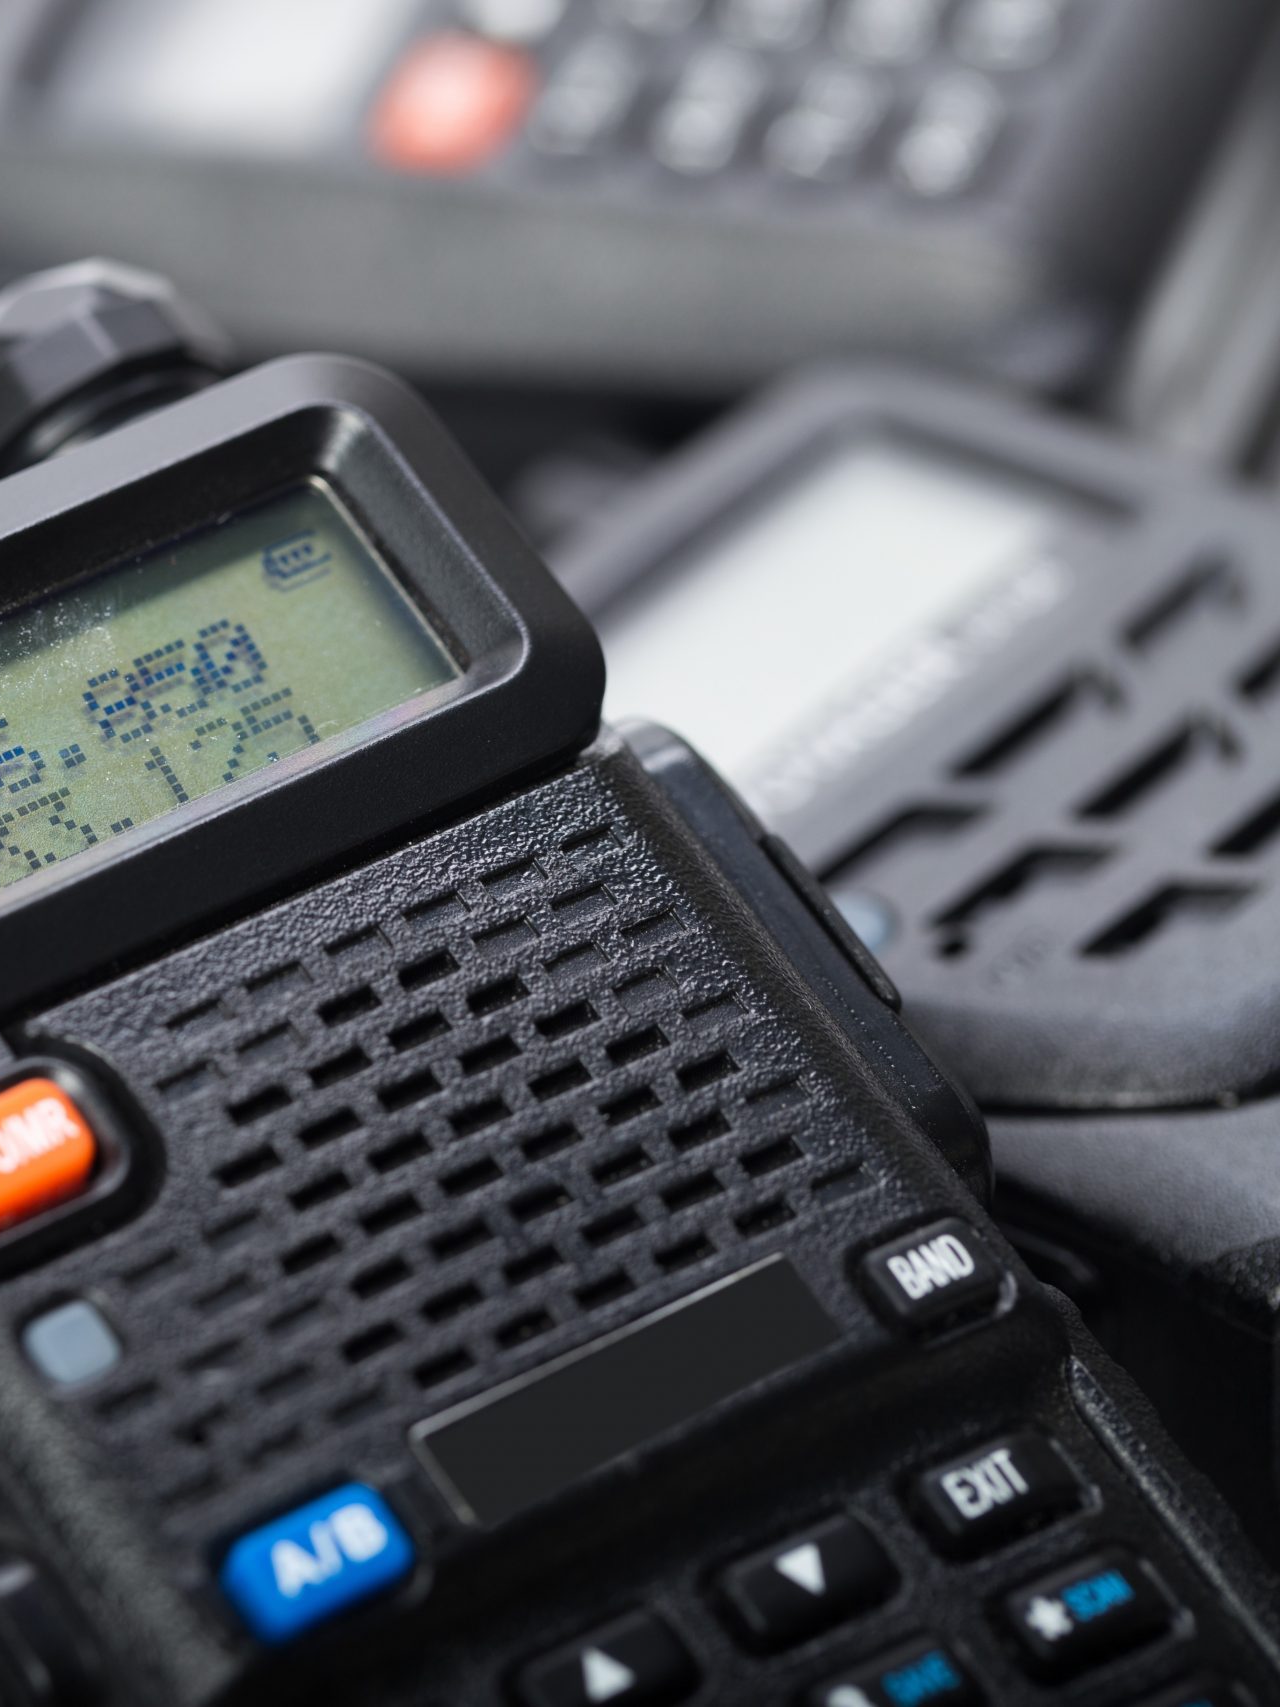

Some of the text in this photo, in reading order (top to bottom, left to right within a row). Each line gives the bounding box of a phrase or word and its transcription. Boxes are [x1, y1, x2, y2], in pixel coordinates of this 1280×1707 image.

[886, 1234, 975, 1300] BAND
[941, 1448, 1030, 1520] EXIT
[271, 1503, 388, 1598] A/B
